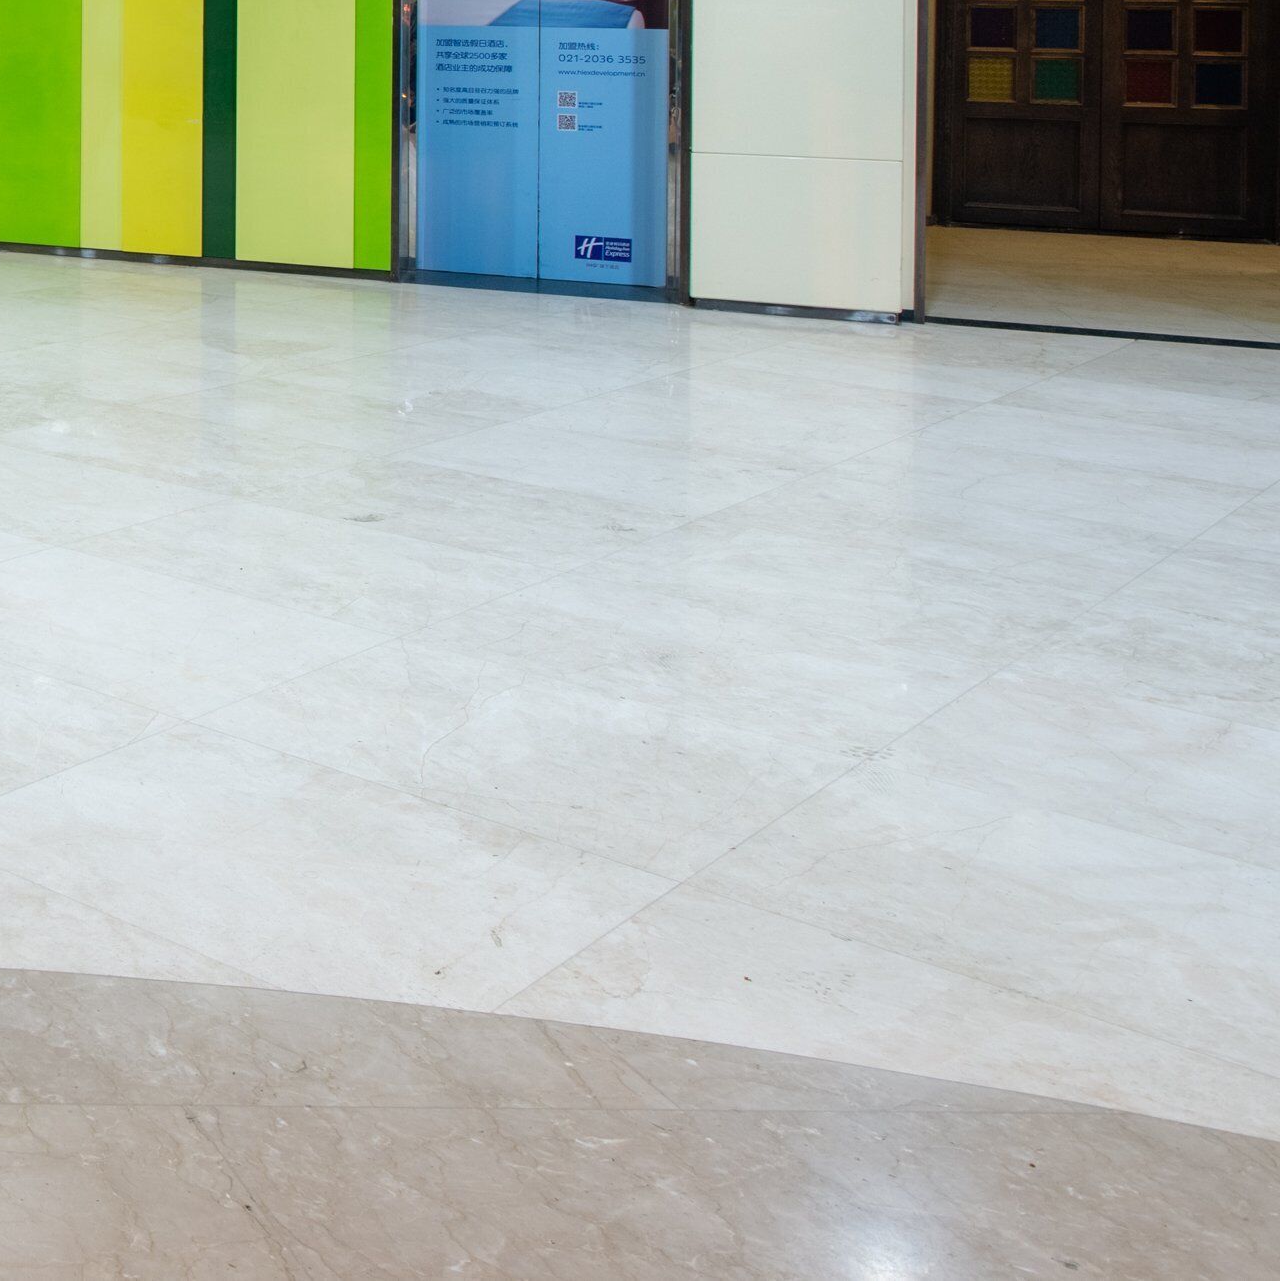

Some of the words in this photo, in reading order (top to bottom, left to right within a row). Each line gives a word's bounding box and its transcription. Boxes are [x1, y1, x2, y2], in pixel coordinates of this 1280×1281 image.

[436, 51, 508, 60] 共享全球2500多家
[558, 54, 614, 63] 021-2036
[618, 55, 646, 64] 3535
[435, 63, 513, 72] 酒店业主的成功保障
